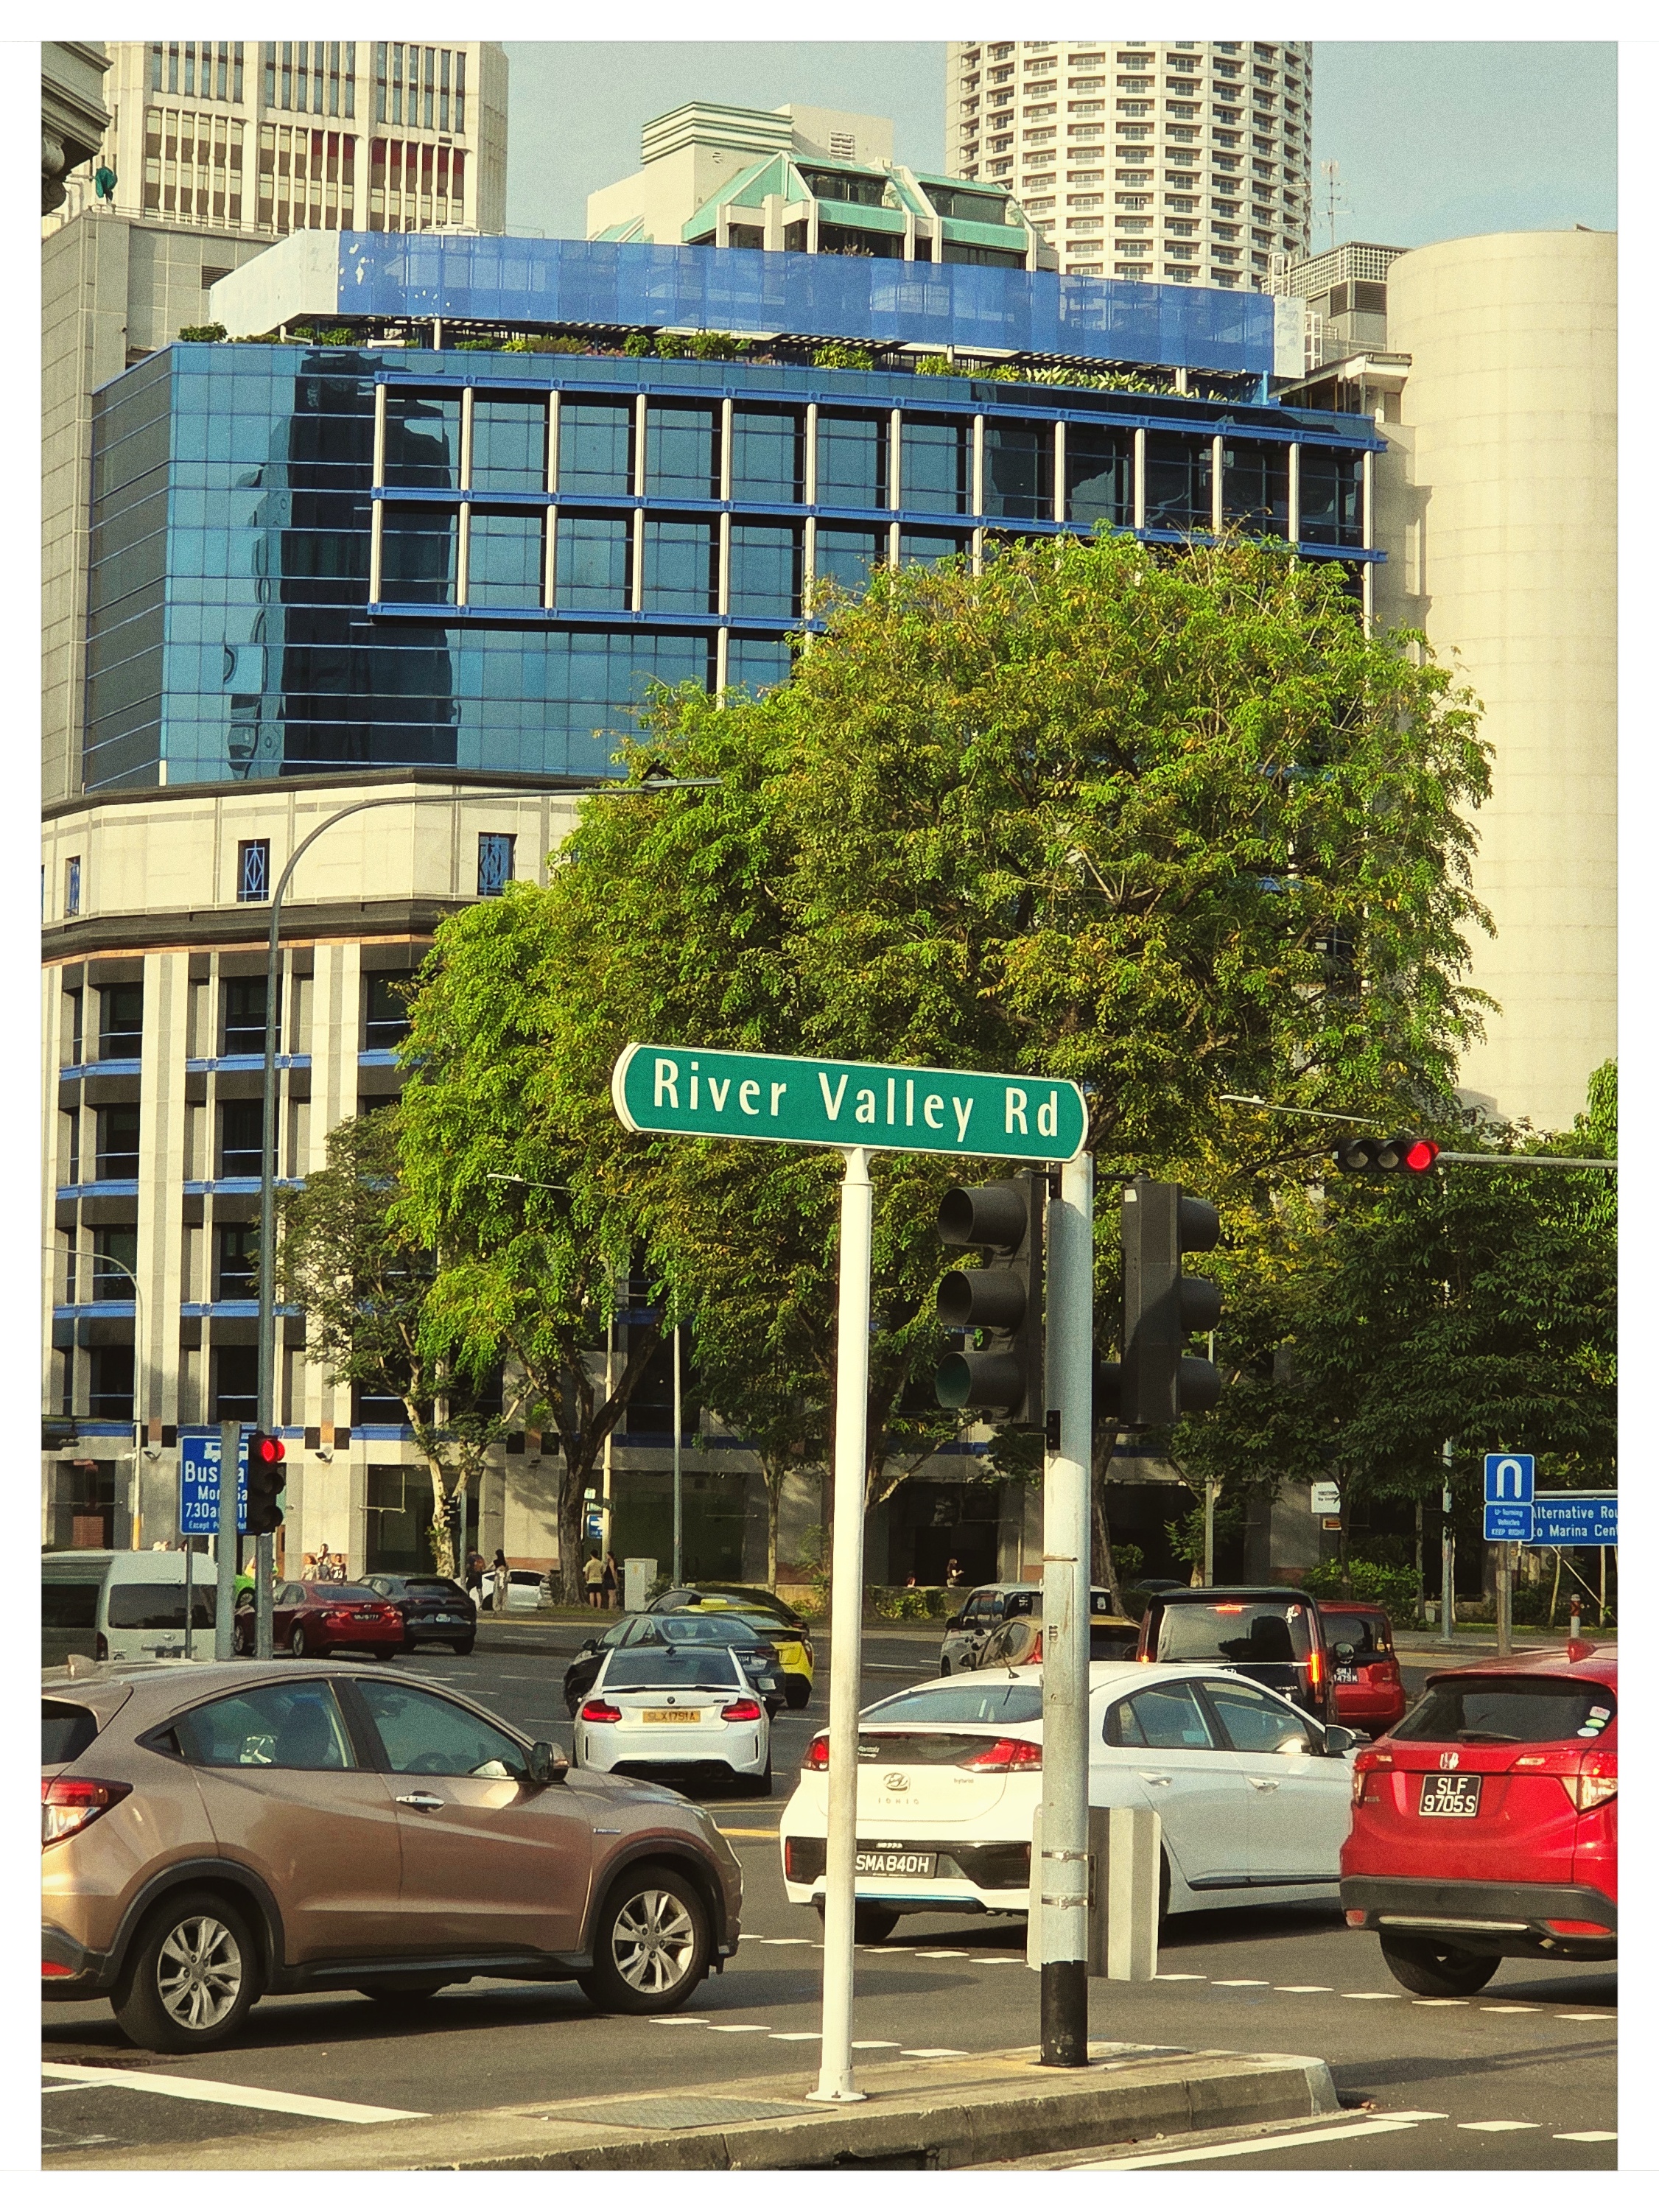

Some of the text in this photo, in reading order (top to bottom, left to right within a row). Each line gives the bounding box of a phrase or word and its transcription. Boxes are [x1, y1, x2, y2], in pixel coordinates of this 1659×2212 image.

[654, 1058, 1059, 1142] River Valley Rd
[185, 1460, 218, 1483] Bus
[186, 1503, 221, 1518] 7.30a
[1549, 1524, 1588, 1537] Marina
[1437, 1777, 1468, 1795] SLF
[1423, 1794, 1476, 1813] 9705S
[855, 1854, 930, 1873] SMA840H
